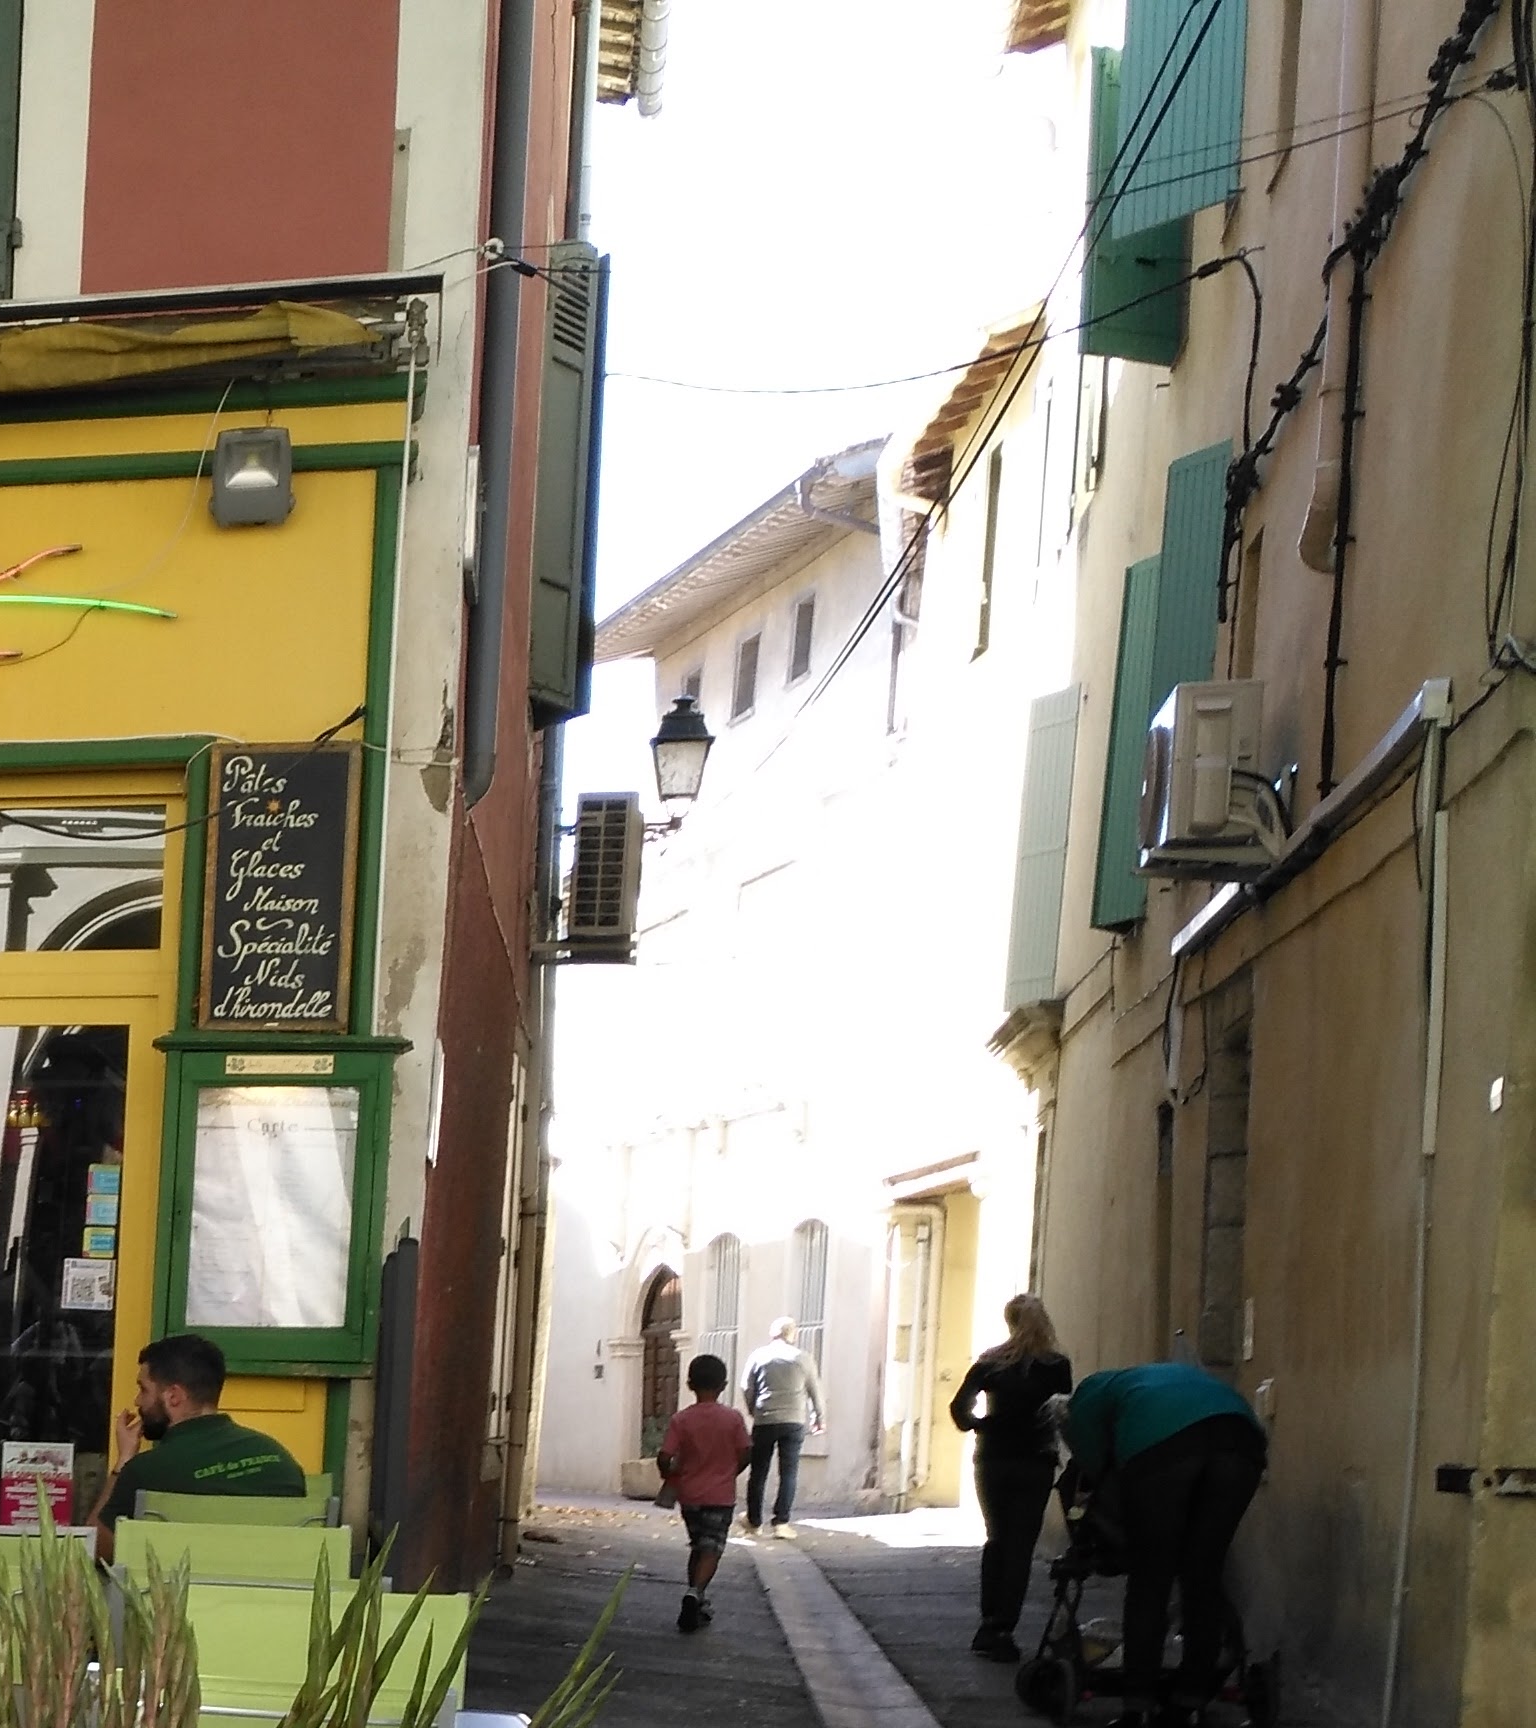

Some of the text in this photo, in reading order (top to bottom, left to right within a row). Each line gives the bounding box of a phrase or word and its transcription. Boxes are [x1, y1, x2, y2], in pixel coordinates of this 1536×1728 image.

[261, 830, 282, 851] et
[226, 849, 306, 902] Glaces
[243, 886, 319, 915] Maison
[217, 919, 334, 973] Spécialité
[244, 959, 306, 990] Nids
[214, 986, 333, 1020] d'hirondelle
[247, 1118, 300, 1133] Carte
